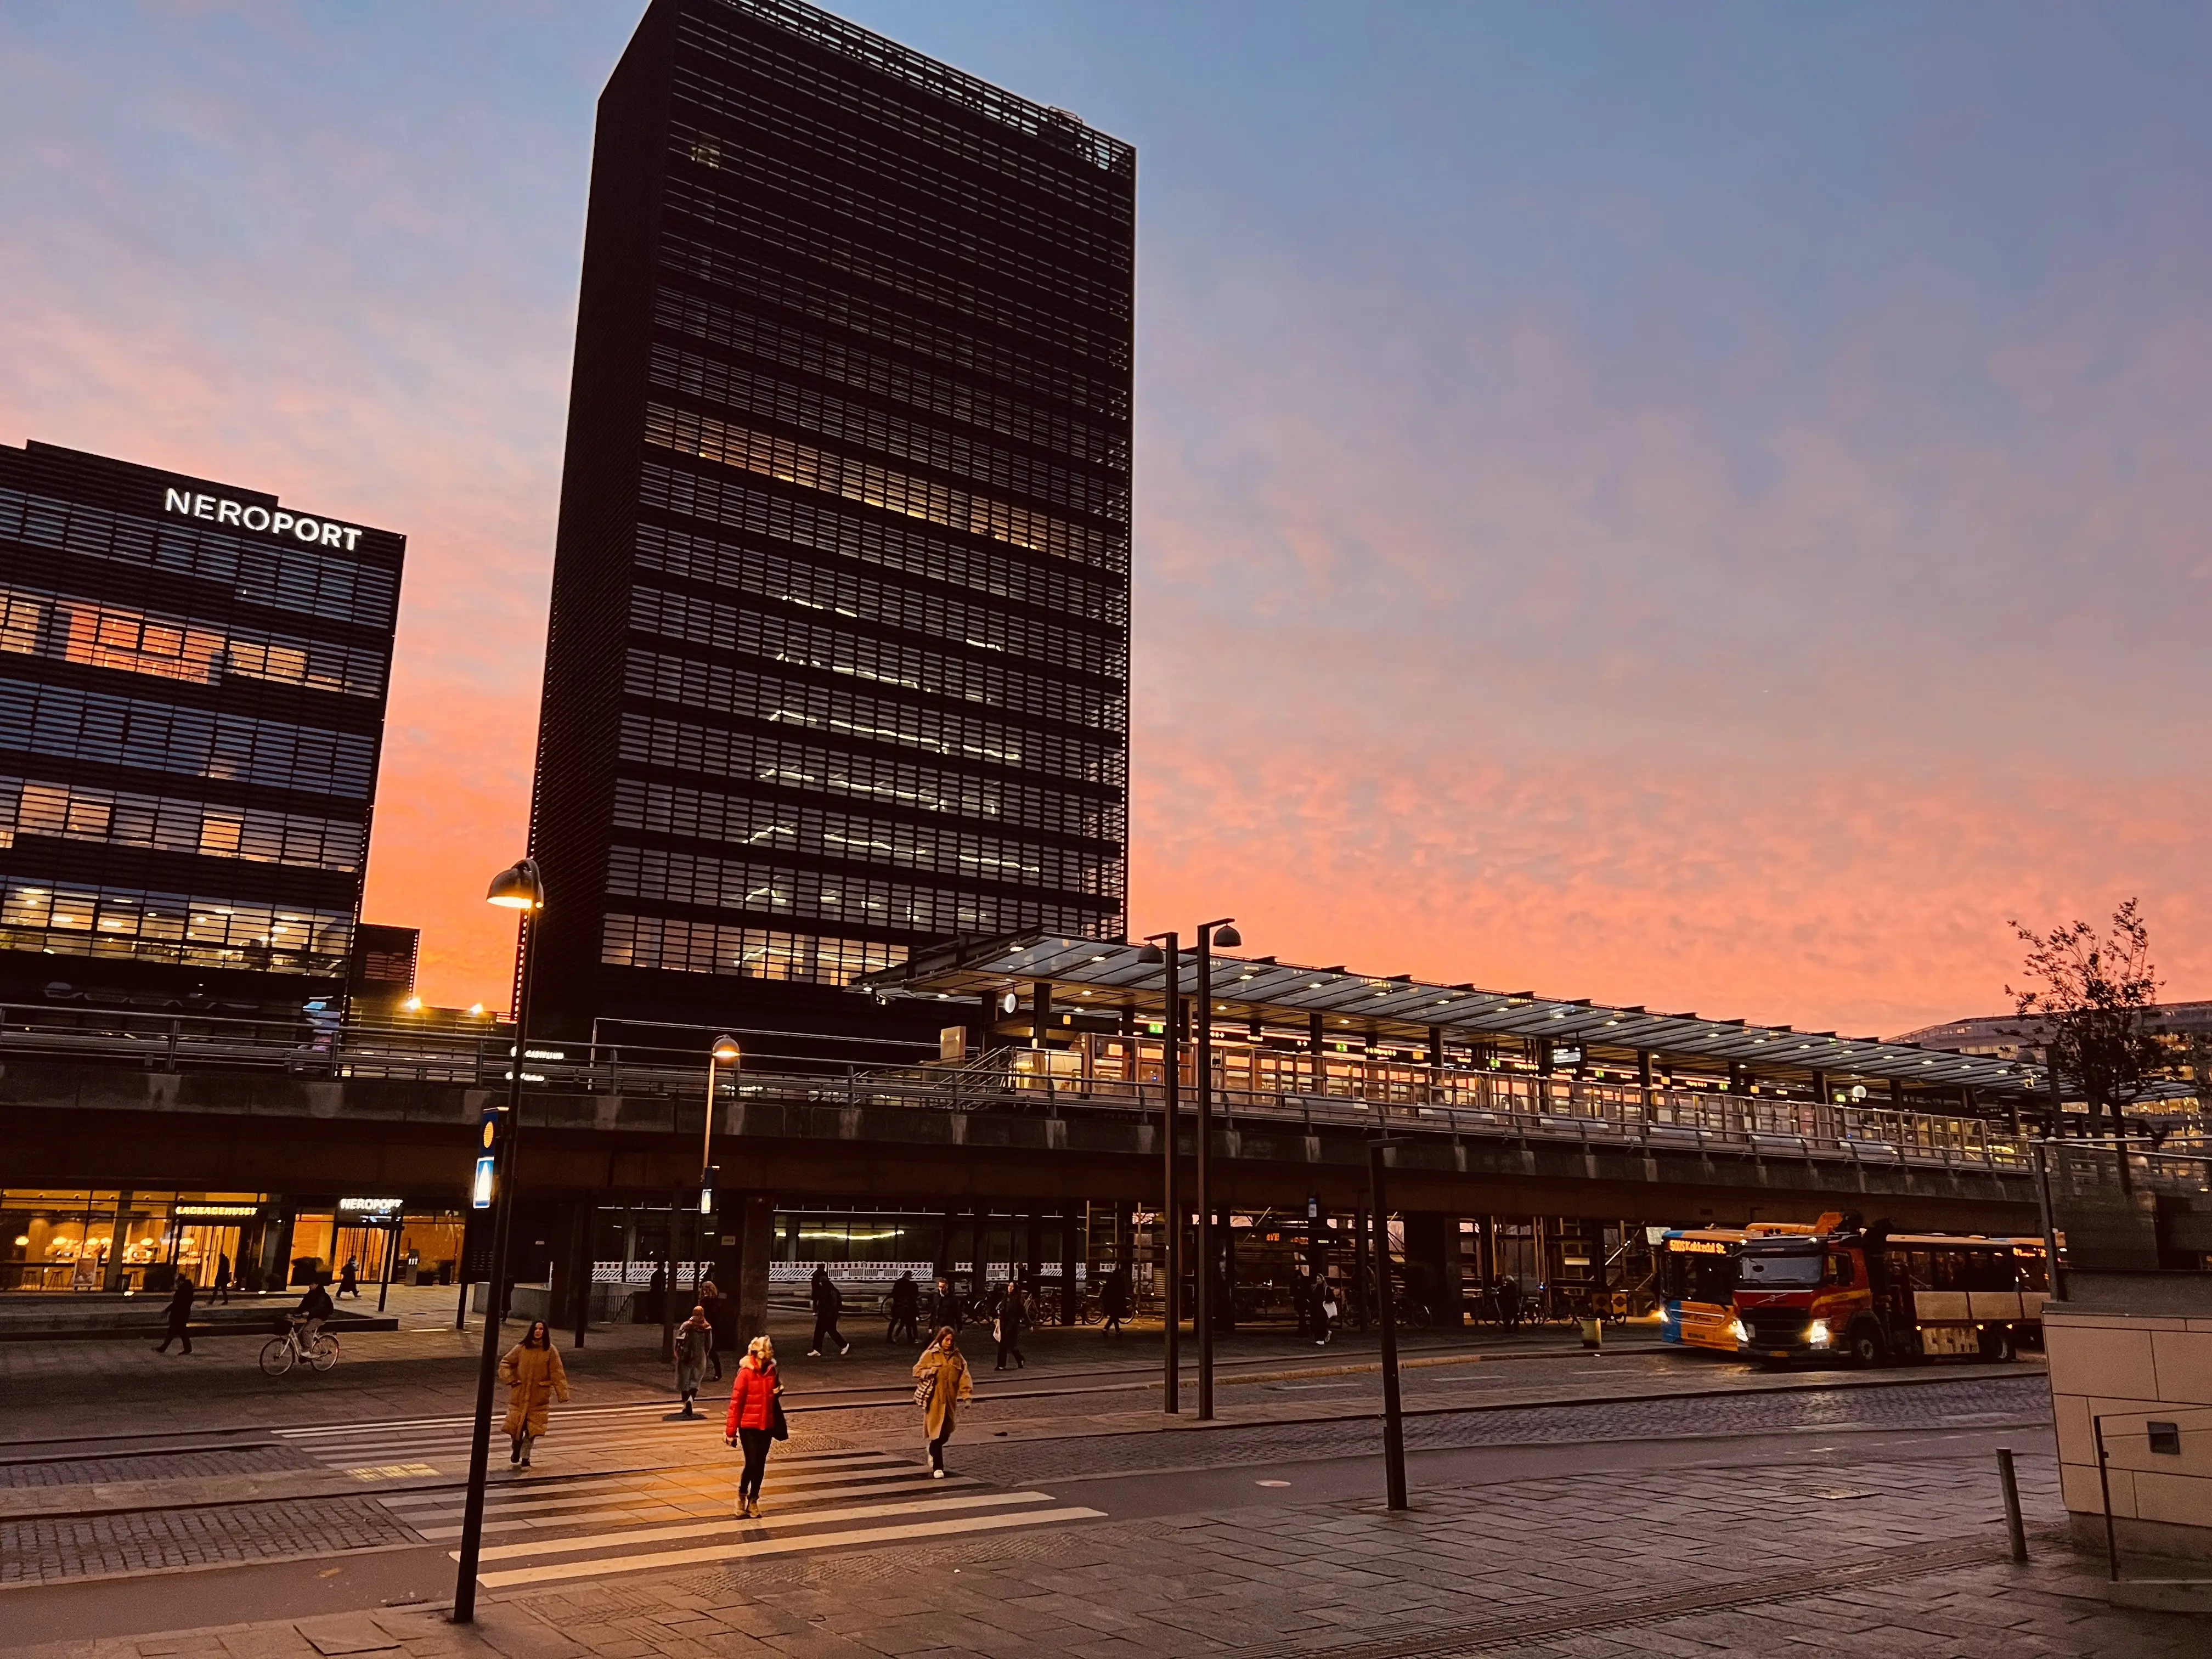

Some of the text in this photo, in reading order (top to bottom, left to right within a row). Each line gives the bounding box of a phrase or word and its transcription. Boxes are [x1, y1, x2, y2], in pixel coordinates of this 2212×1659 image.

[165, 487, 363, 551] NEROPORT
[176, 1206, 258, 1215] LAGKAGEHUSET
[340, 1198, 403, 1210] NEROPORT
[1669, 1239, 1726, 1254] 500S Kokkedal St.
